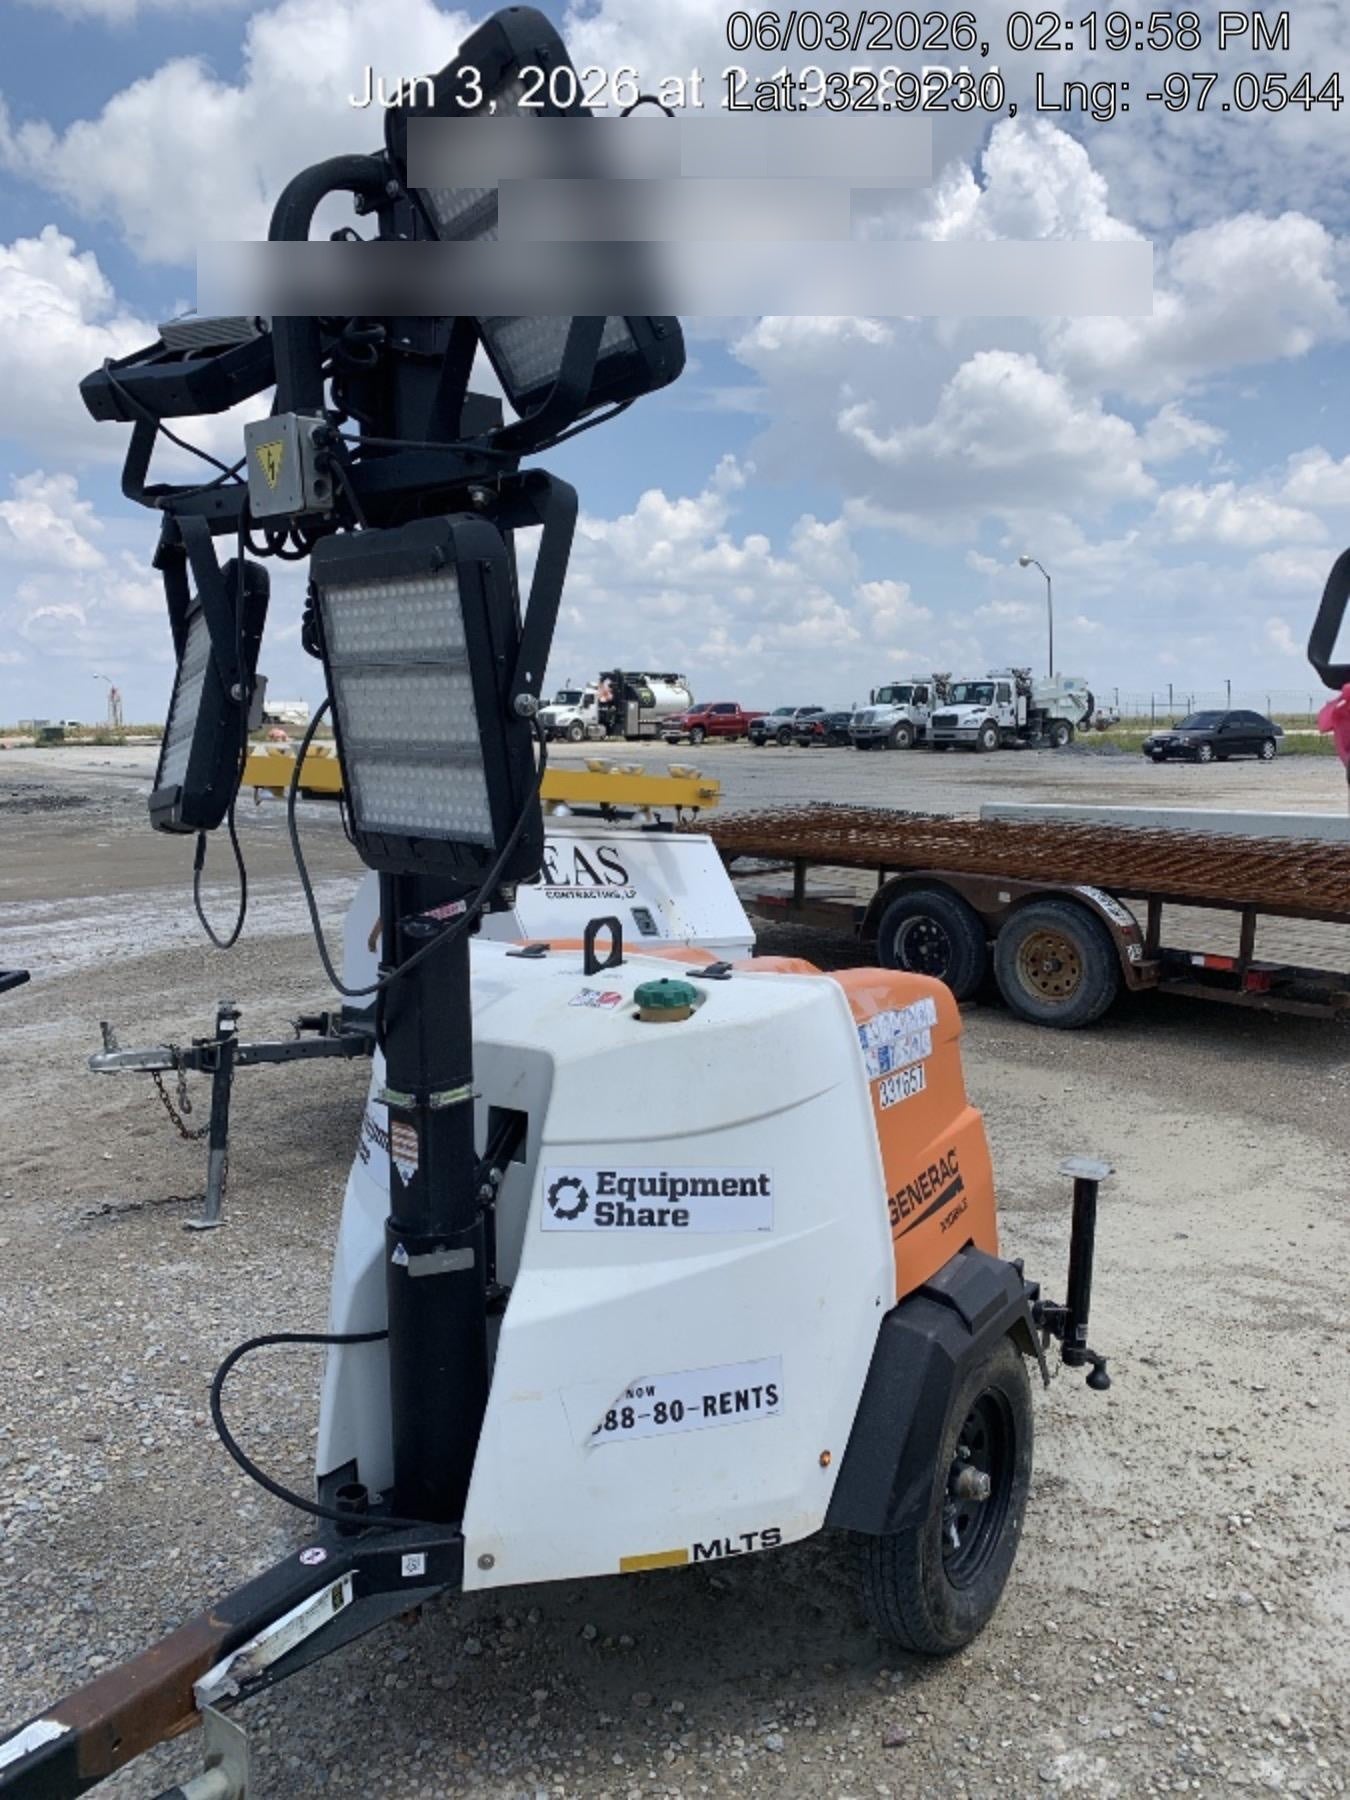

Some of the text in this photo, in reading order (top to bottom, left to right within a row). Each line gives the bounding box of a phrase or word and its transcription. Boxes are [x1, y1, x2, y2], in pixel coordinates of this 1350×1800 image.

[879, 1064, 924, 1108] 331657
[596, 1171, 771, 1202] Equipment
[887, 1148, 960, 1227] GENERAC
[594, 1201, 690, 1228] Share
[625, 1386, 656, 1399] NOW
[692, 1527, 783, 1561] MLTS
